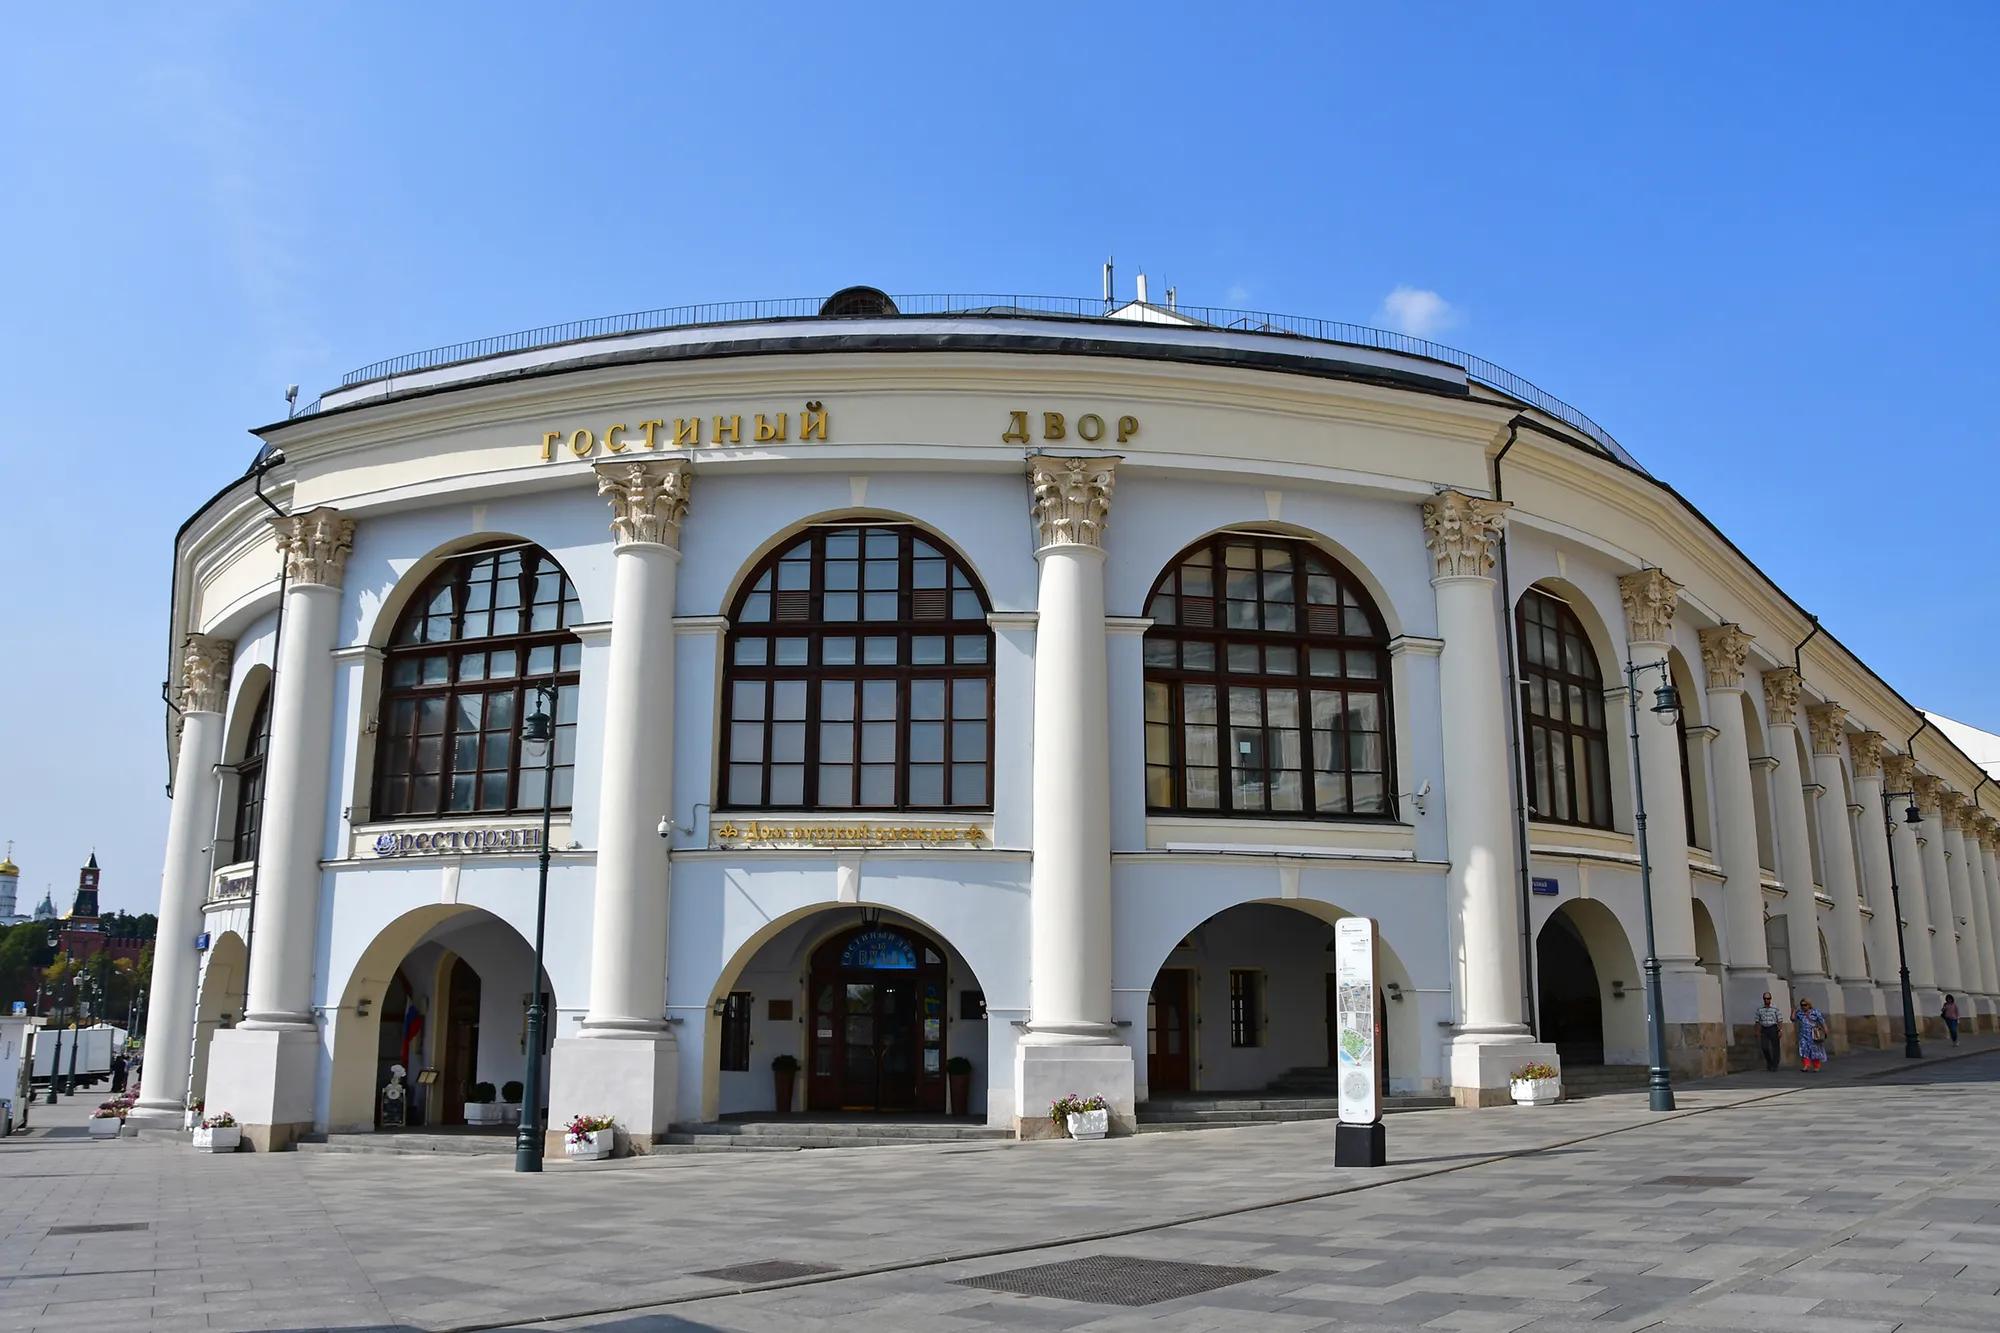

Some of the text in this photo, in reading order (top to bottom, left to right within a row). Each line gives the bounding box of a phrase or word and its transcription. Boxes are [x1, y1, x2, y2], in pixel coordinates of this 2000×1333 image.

[540, 401, 1140, 460] ГОСТИНЫЙ ДВОР
[399, 829, 540, 850] ресторан
[744, 821, 786, 842] Дом
[794, 823, 869, 843] русской
